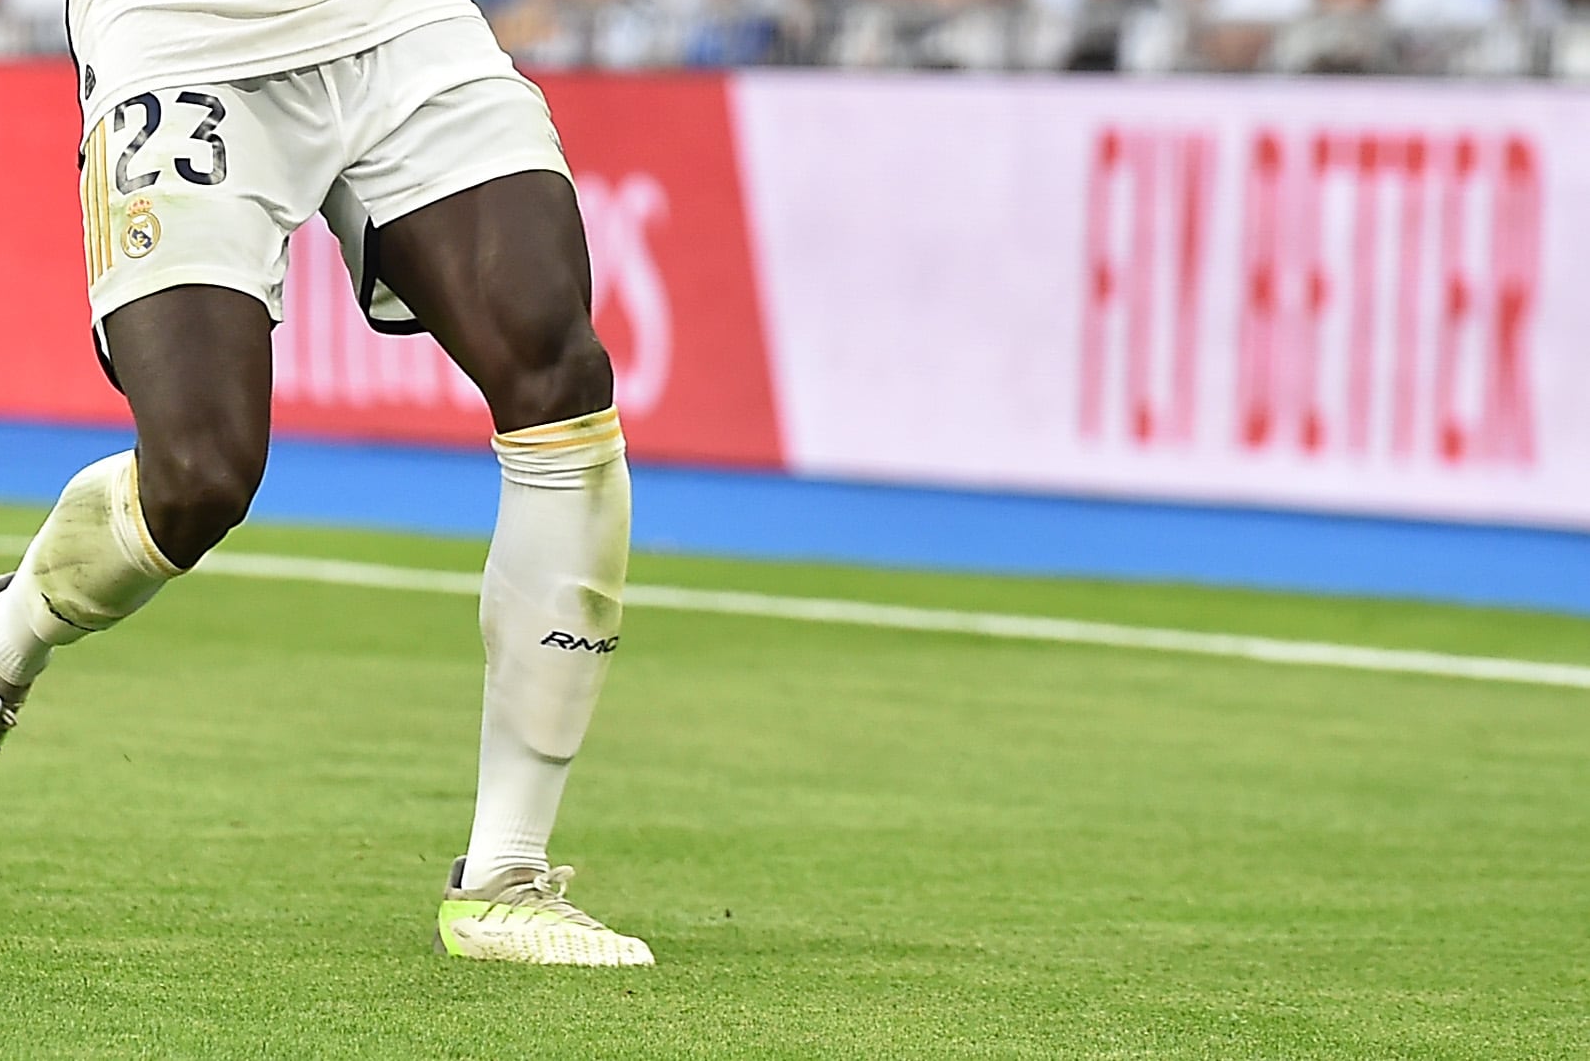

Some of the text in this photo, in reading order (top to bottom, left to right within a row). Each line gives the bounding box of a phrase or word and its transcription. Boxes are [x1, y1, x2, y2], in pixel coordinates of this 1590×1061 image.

[113, 91, 228, 195] 23
[1081, 122, 1546, 470] FLY BETTER
